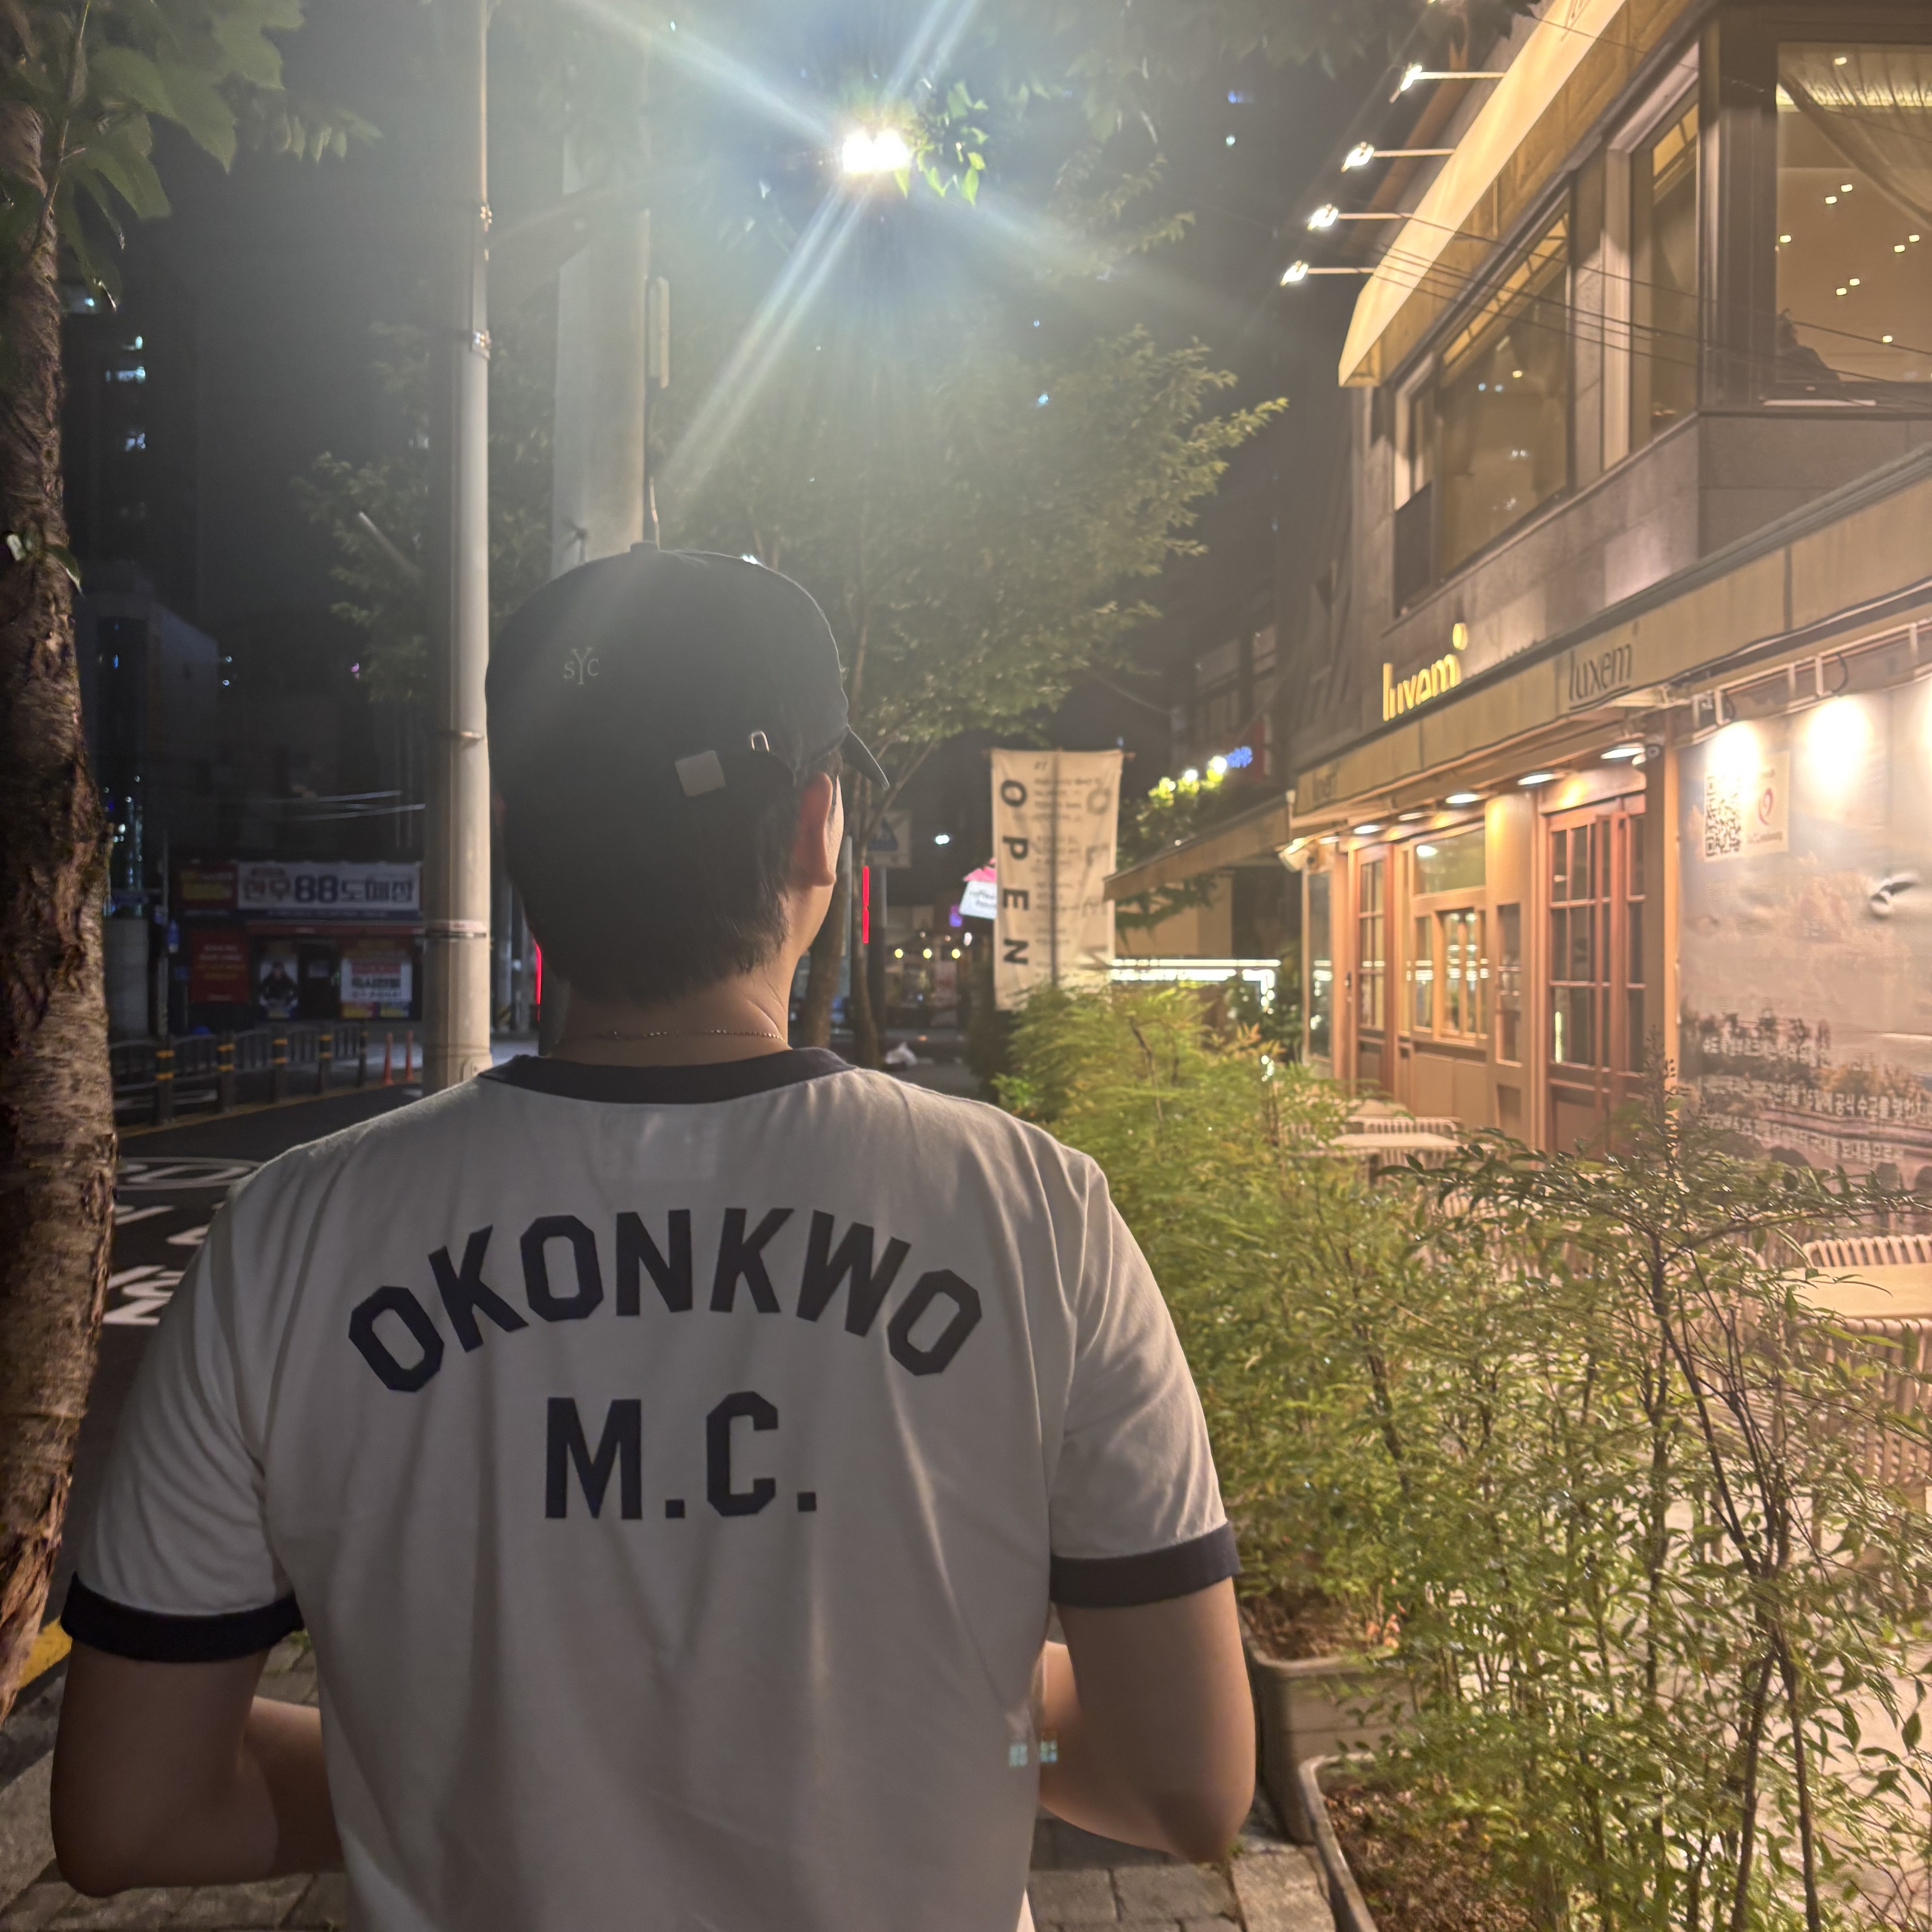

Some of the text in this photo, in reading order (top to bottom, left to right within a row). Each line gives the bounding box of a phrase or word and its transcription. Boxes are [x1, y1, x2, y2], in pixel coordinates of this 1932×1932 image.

[1569, 643, 1632, 701] luxem
[1000, 779, 1030, 966] OPEN
[348, 1208, 982, 1393] OKONKWO
[544, 1391, 817, 1520] M.C.
